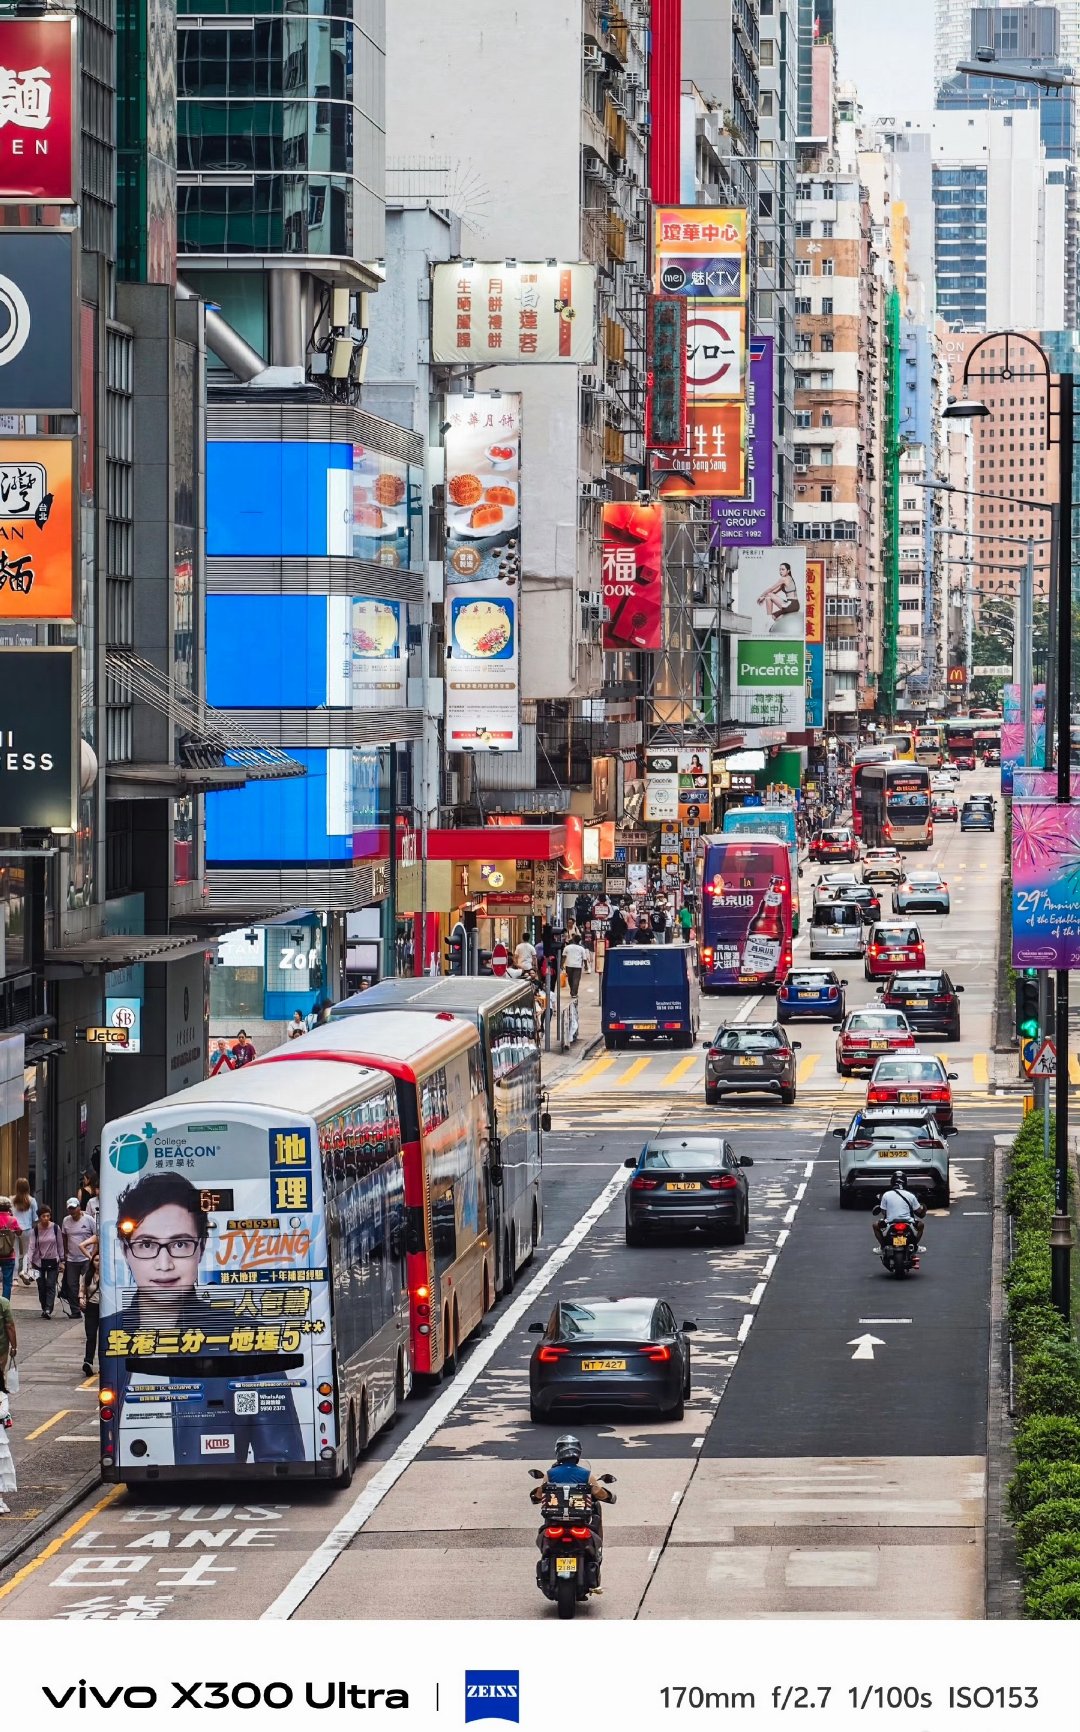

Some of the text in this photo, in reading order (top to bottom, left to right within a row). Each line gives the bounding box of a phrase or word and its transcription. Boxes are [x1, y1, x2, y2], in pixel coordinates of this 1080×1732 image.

[664, 224, 738, 241] 瓊華中心
[664, 274, 682, 283] mei
[691, 271, 739, 285] 魅KTV
[692, 459, 709, 473] Sang
[710, 459, 727, 473] Sang
[38, 503, 48, 521] 台北
[717, 509, 766, 517] LUNG FUNG
[725, 518, 757, 527] GROUP
[773, 653, 798, 665] 實惠
[741, 664, 799, 676] Pricerite
[0, 753, 53, 771] ESS
[1026, 914, 1035, 927] of
[1037, 914, 1048, 924] the
[1051, 926, 1074, 939] of the
[154, 1137, 187, 1146] College
[154, 1146, 216, 1158] BEACON
[234, 1219, 275, 1229] TG 1931
[220, 1272, 258, 1284] 港大地理
[205, 1438, 230, 1450] KMB
[120, 1504, 291, 1522] BUS
[71, 1528, 290, 1549] LANE
[49, 1555, 237, 1587] 巴士
